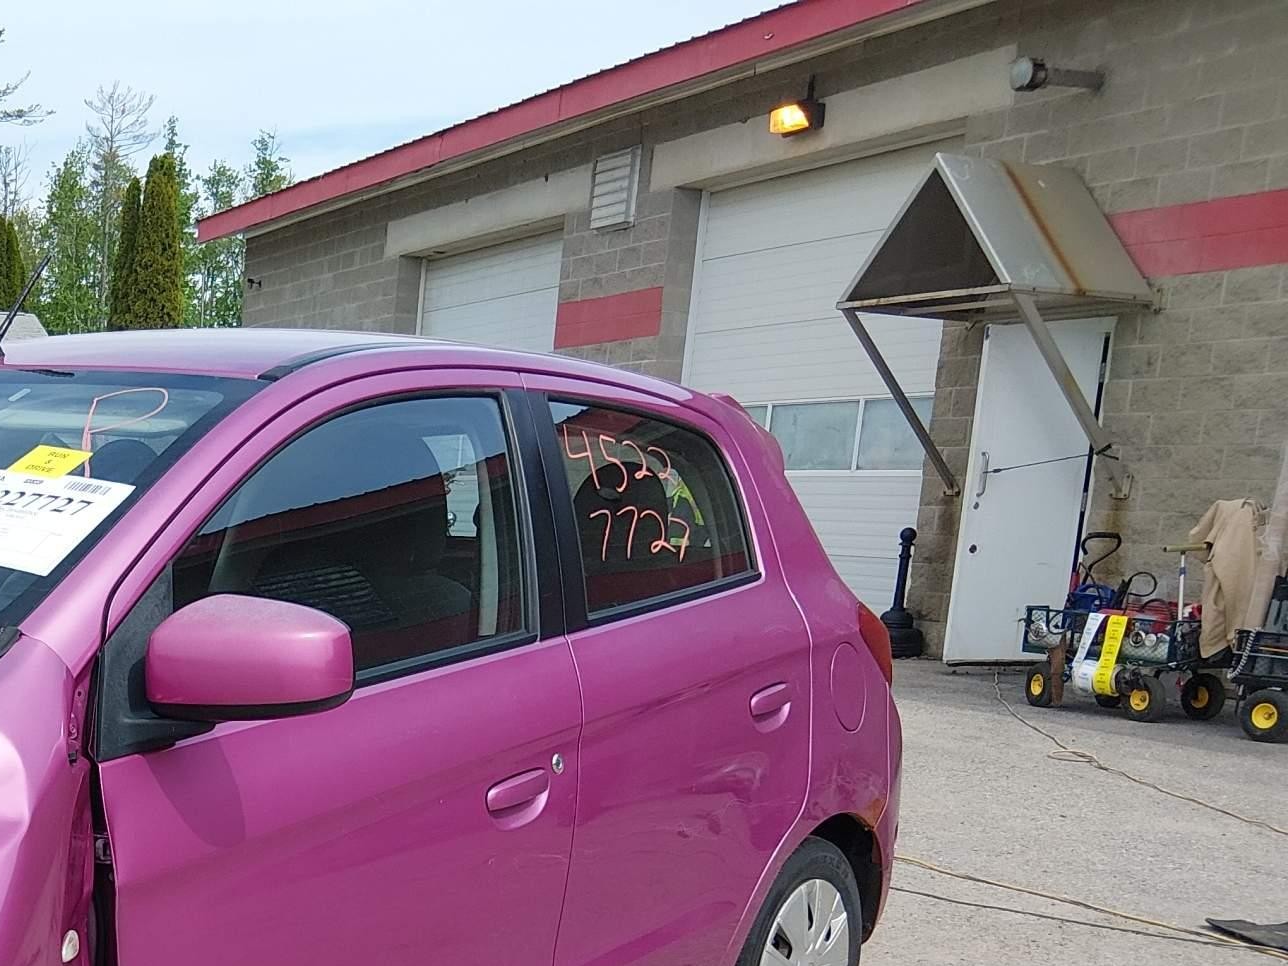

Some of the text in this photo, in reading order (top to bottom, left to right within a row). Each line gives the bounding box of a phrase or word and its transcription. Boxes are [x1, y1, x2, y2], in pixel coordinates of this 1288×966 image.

[25, 464, 55, 473] DRIVE
[48, 451, 70, 459] RUN
[562, 424, 678, 493] 4522
[589, 506, 690, 563] 7727
